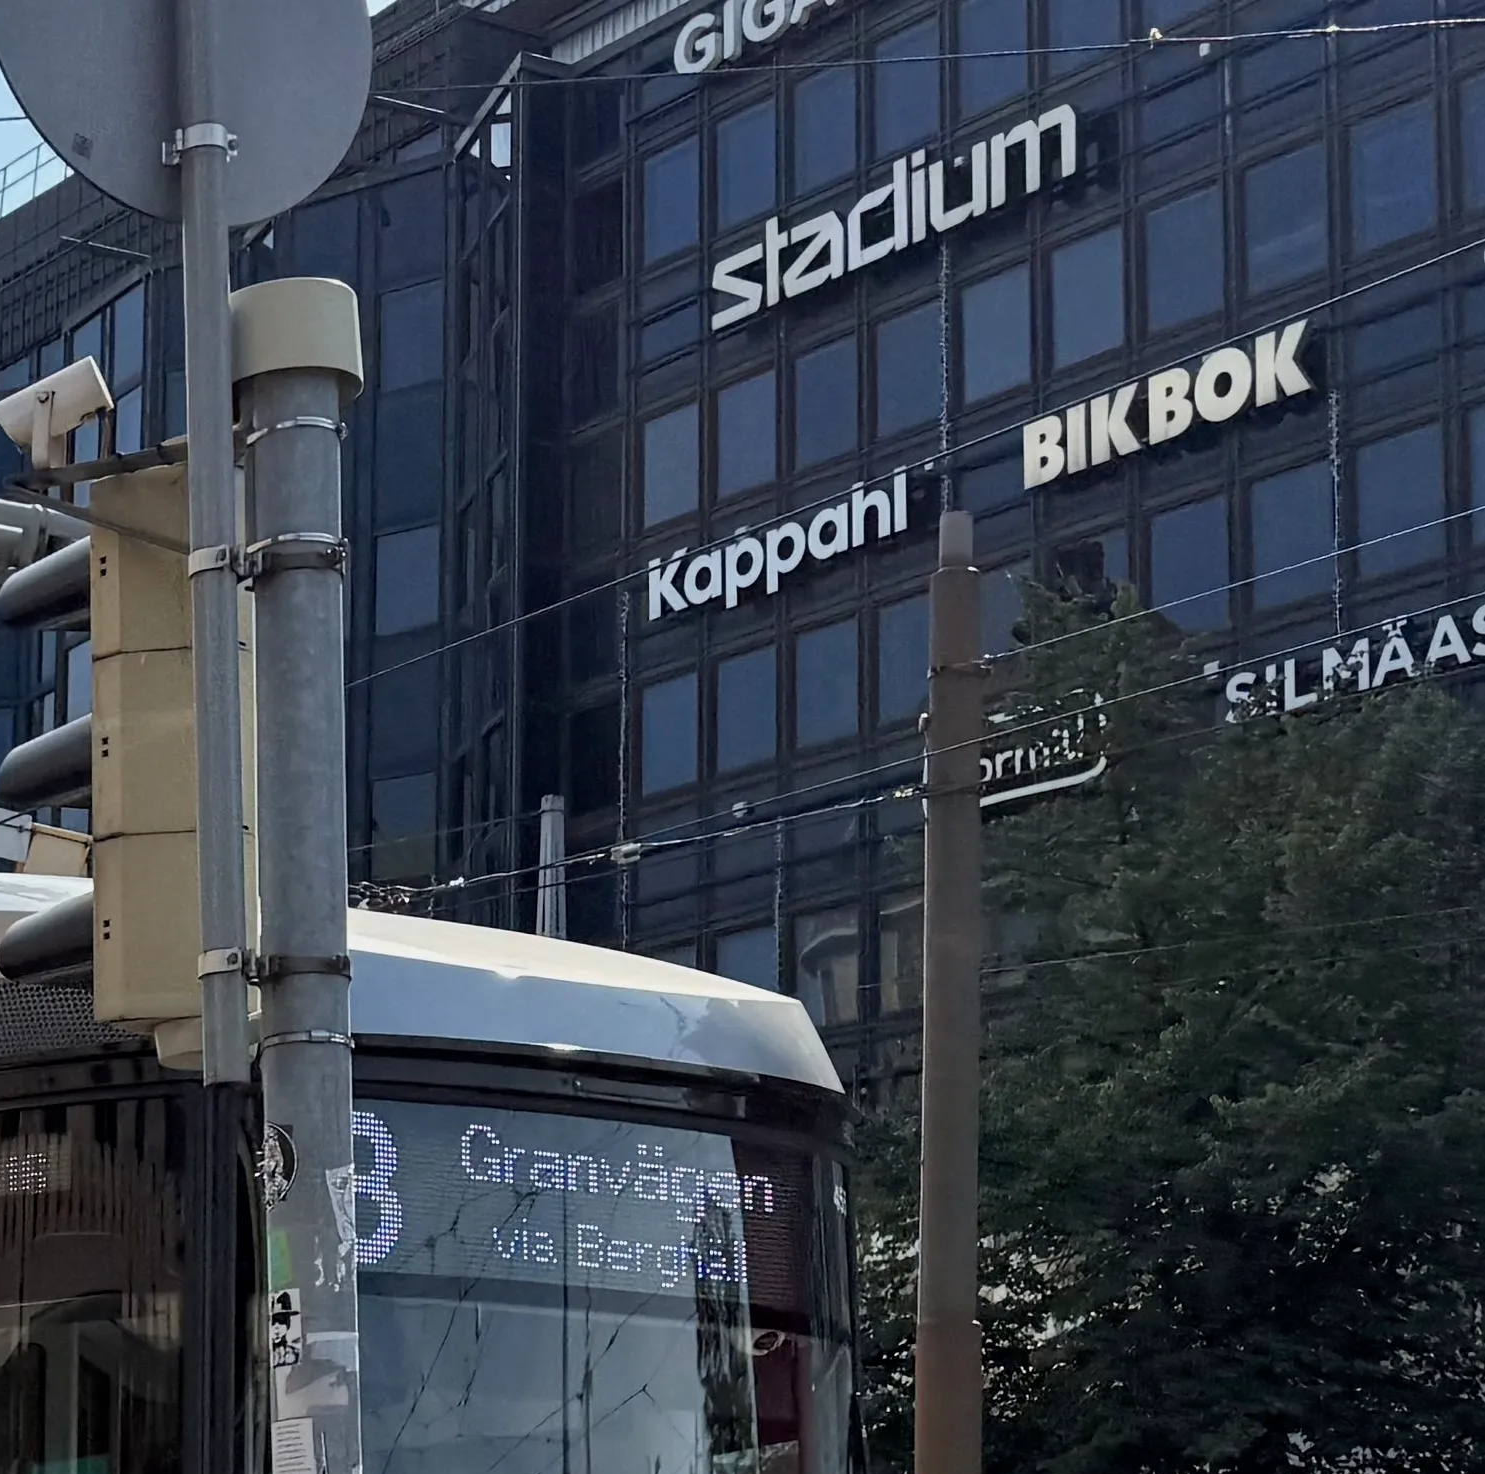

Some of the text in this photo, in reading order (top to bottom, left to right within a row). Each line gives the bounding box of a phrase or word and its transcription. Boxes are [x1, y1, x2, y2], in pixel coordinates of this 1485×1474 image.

[711, 103, 1078, 331] stadium
[1022, 317, 1313, 491] BIK BOK
[647, 464, 909, 622] Kappahl
[460, 1123, 775, 1224] Granvägen
[492, 1217, 559, 1265] via
